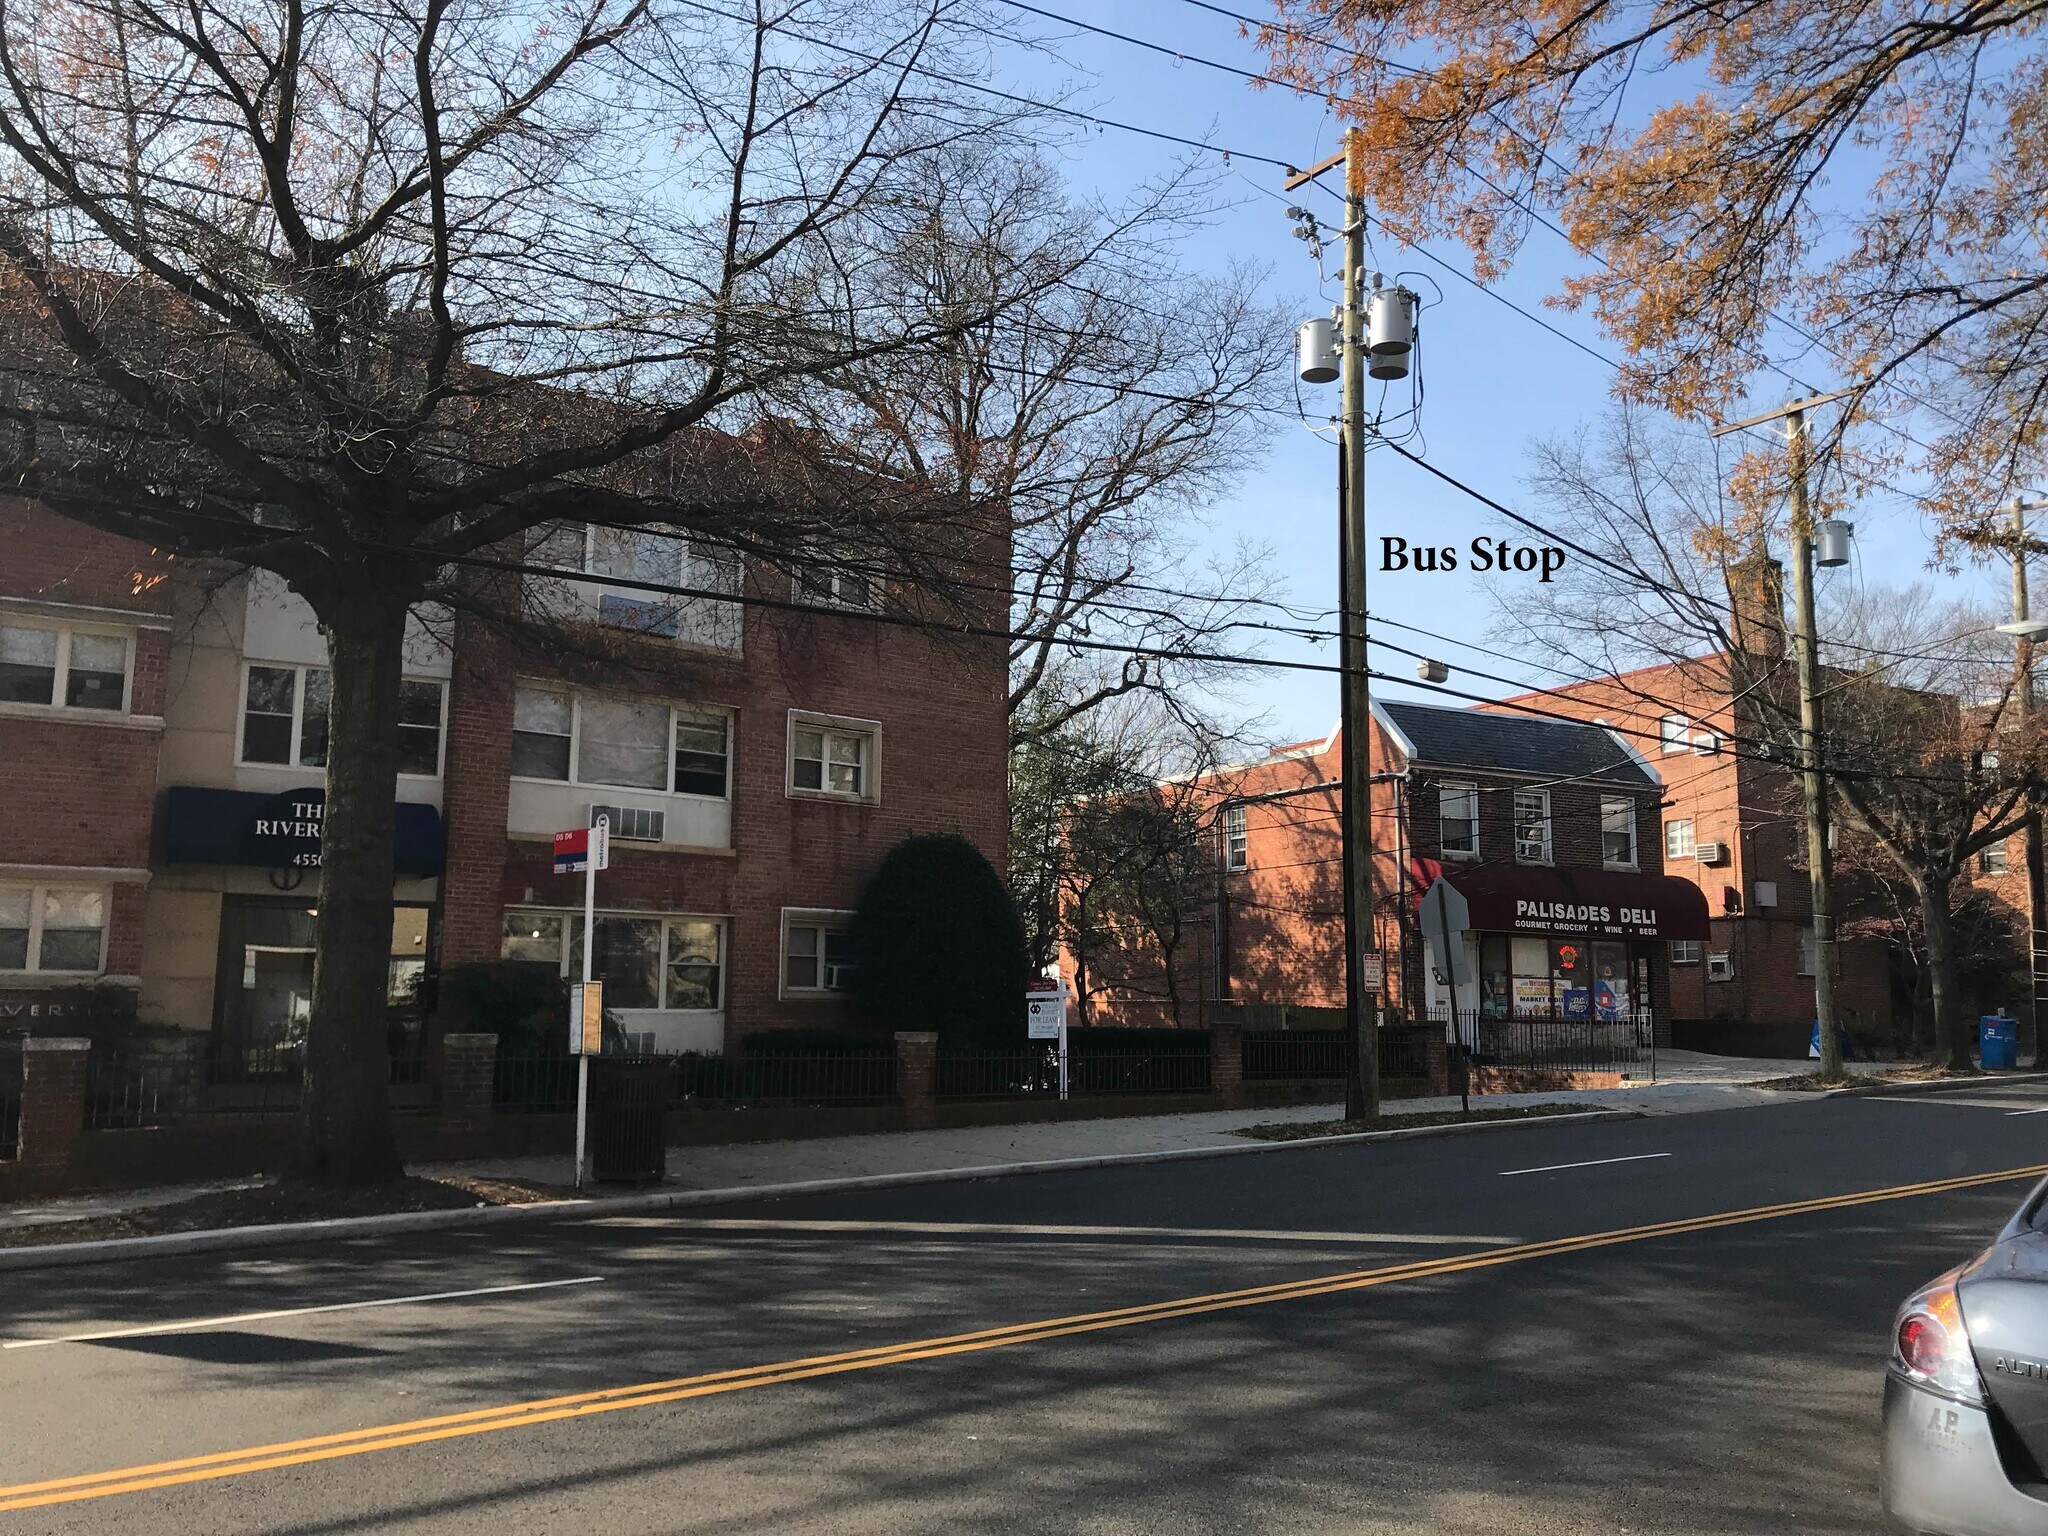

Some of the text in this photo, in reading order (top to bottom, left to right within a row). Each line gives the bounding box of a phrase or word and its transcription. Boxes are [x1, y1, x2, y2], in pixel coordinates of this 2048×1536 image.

[292, 803, 322, 819] TH
[256, 820, 320, 837] RIVER
[1516, 900, 1657, 925] PALISADES DELI
[1515, 920, 1658, 936] GOURMET GROCERY WINE BEER
[1995, 1356, 2048, 1380] ALTI
